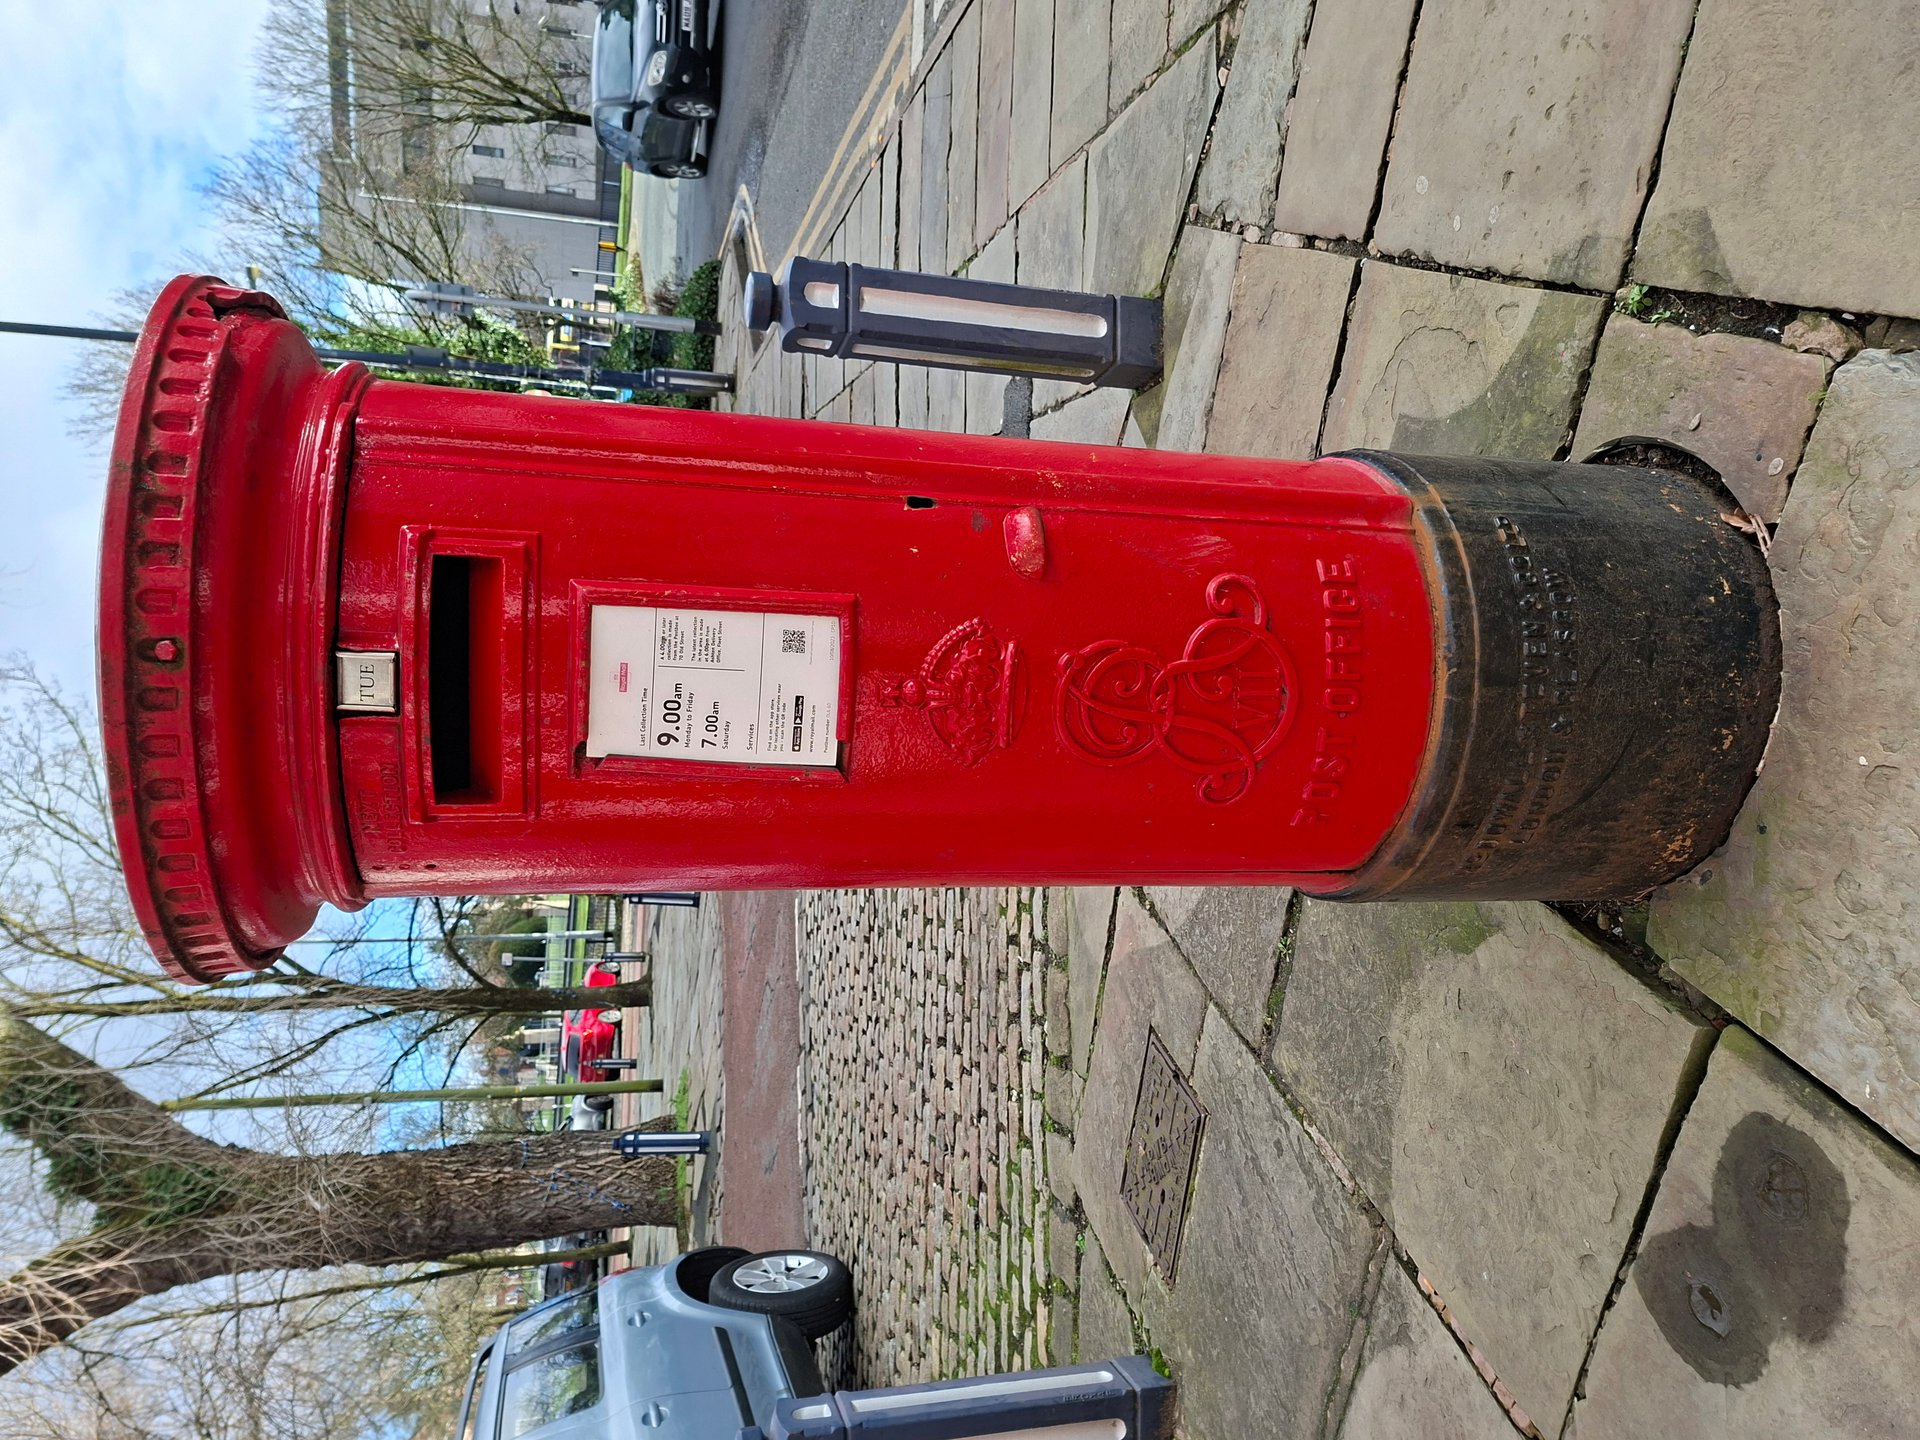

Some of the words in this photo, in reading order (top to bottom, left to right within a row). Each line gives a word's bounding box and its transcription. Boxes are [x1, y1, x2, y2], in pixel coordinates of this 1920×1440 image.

[1315, 558, 1361, 712] OFFICE
[1541, 567, 1578, 706] GLASGOW
[359, 664, 374, 702] TUE
[686, 692, 694, 712] Friday
[656, 683, 682, 746] 9.00am
[684, 723, 693, 748] Monday
[702, 701, 720, 748] 7.00am
[722, 720, 731, 750] Saturday
[1549, 713, 1575, 737] &
[1289, 727, 1355, 826] POST
[1508, 743, 1568, 844] LONDON
[358, 789, 380, 835] NEXT
[379, 762, 408, 854] COLLECTION
